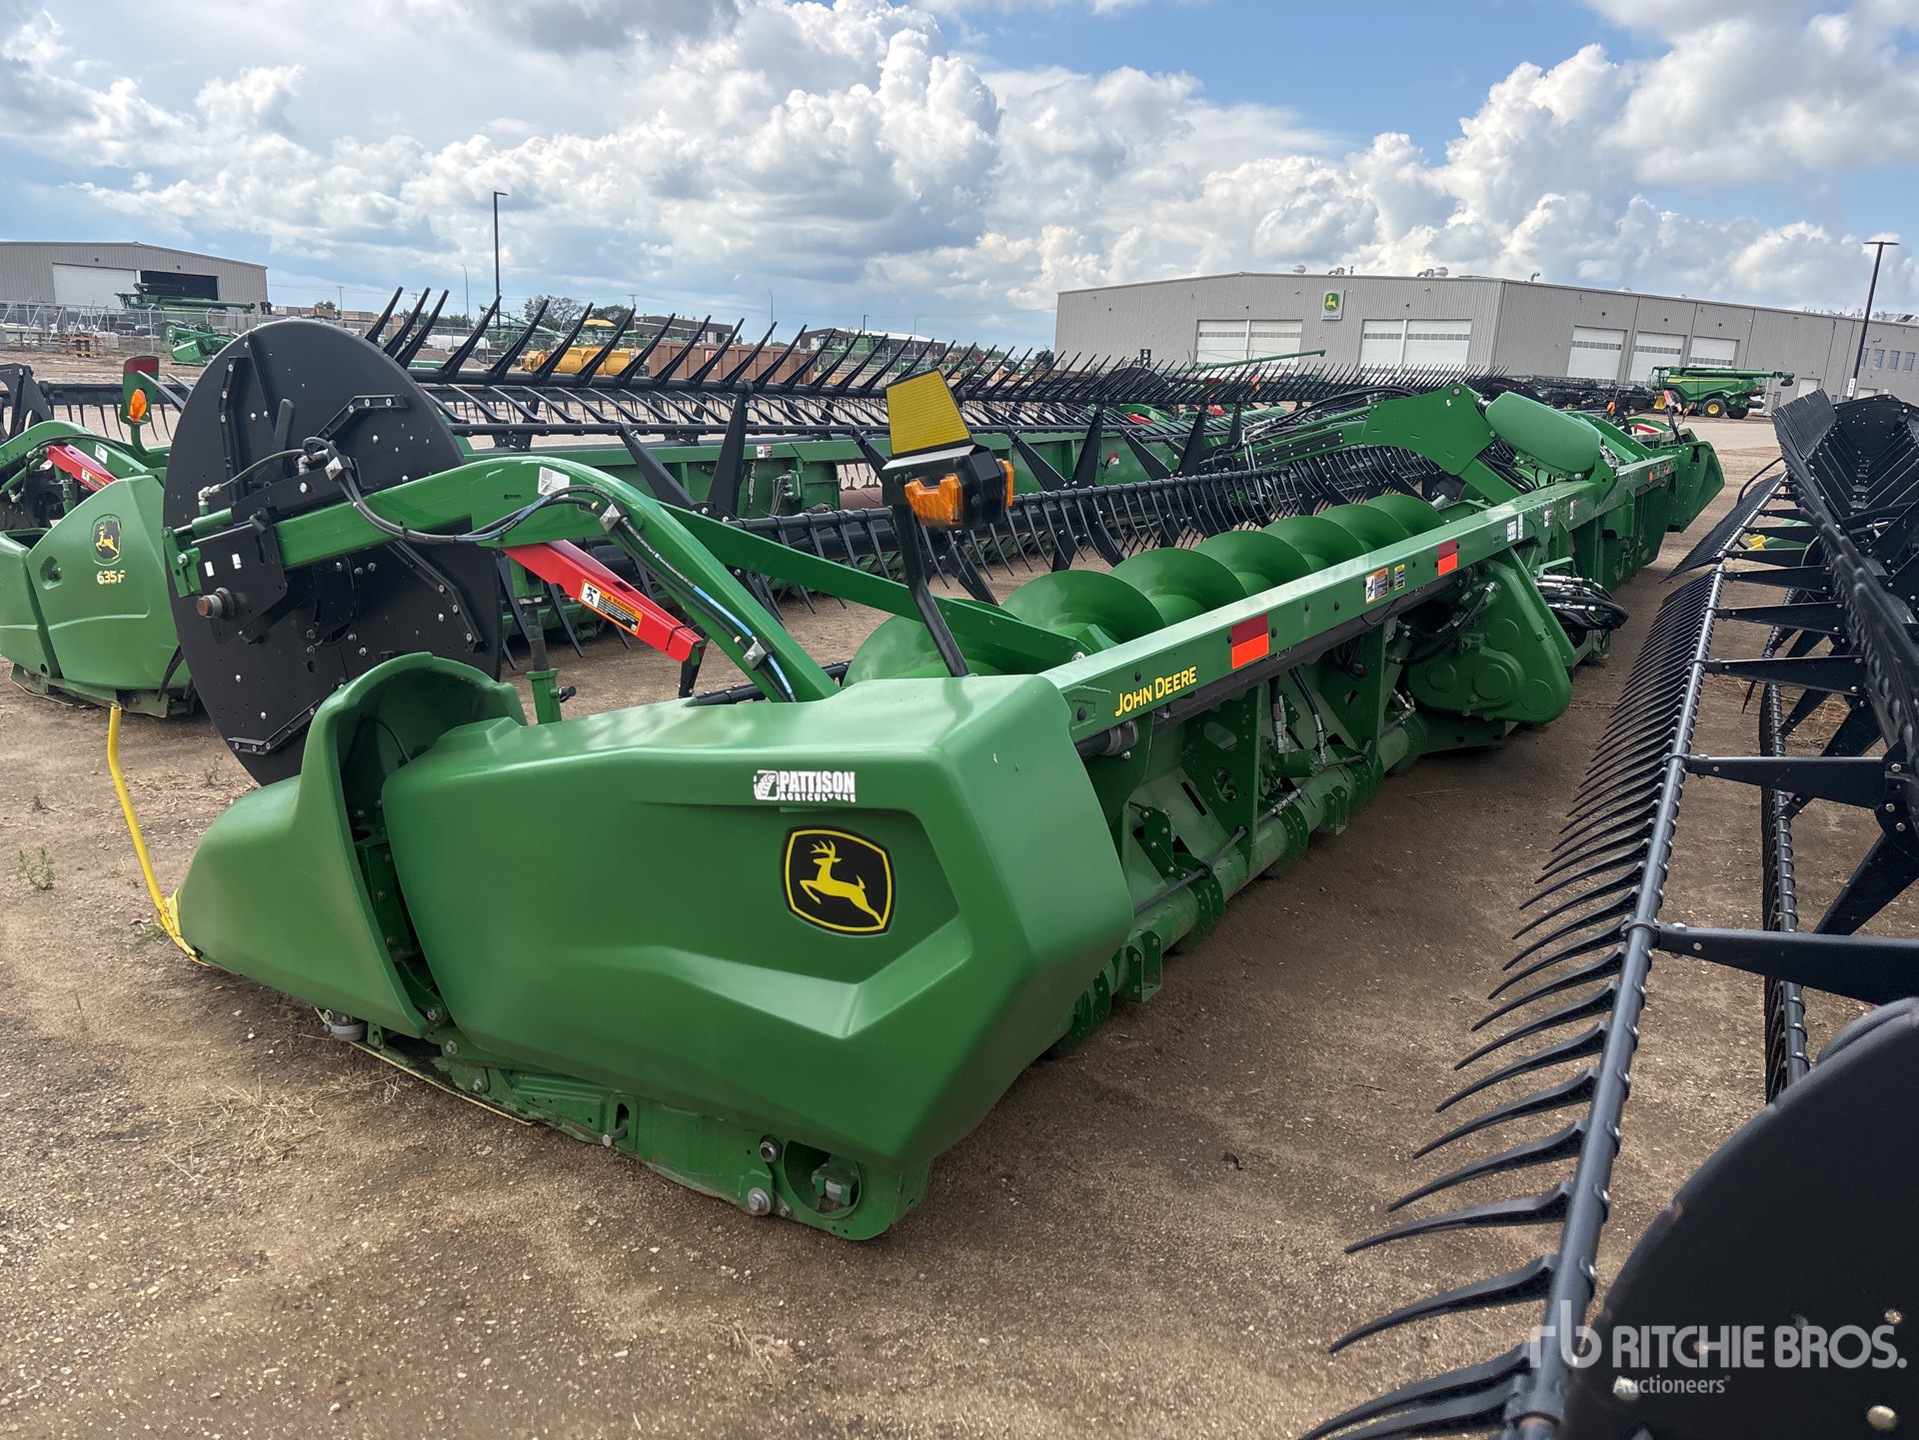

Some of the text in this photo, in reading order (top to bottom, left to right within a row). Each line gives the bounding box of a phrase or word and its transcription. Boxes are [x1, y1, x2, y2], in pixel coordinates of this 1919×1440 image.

[1115, 666, 1197, 717] JOHN DEERE
[779, 770, 855, 793] PATTISON
